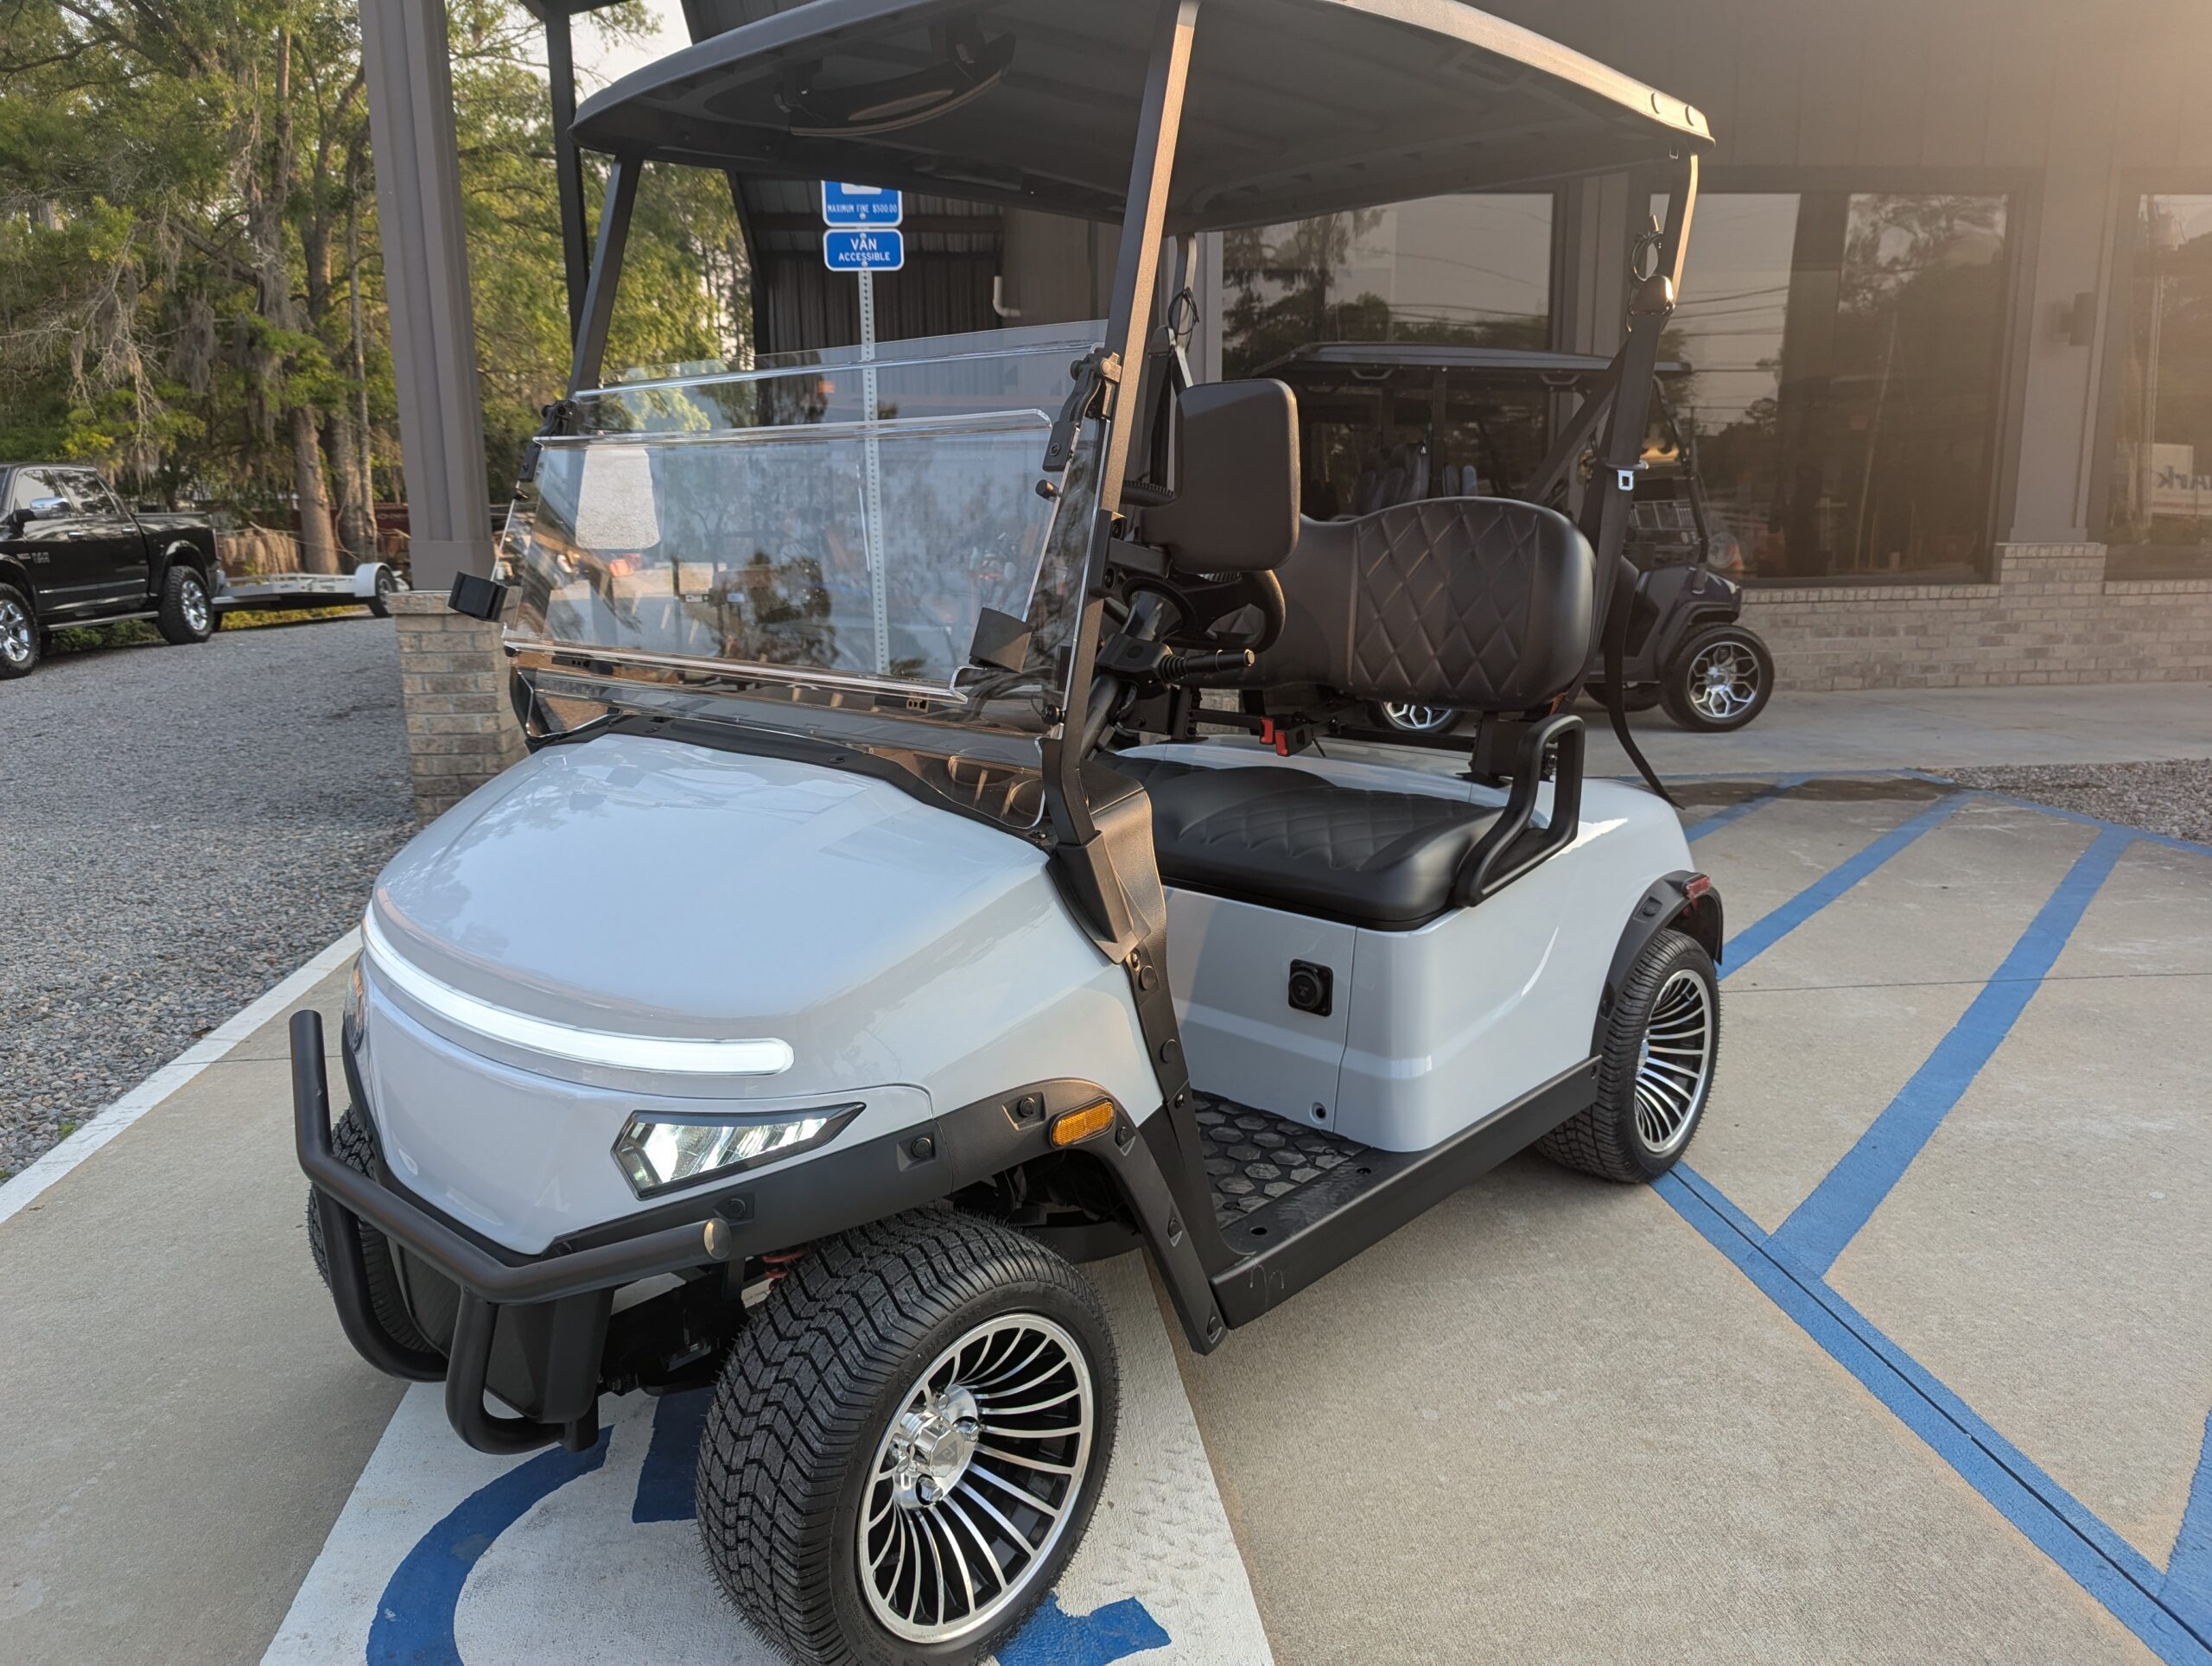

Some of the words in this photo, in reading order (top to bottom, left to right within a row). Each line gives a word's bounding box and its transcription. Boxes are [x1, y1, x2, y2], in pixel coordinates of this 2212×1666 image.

[827, 204, 855, 213] MAXIMUM
[856, 204, 869, 213] FINE
[850, 238, 877, 251] VAN
[838, 252, 891, 262] ACCESSIBLE
